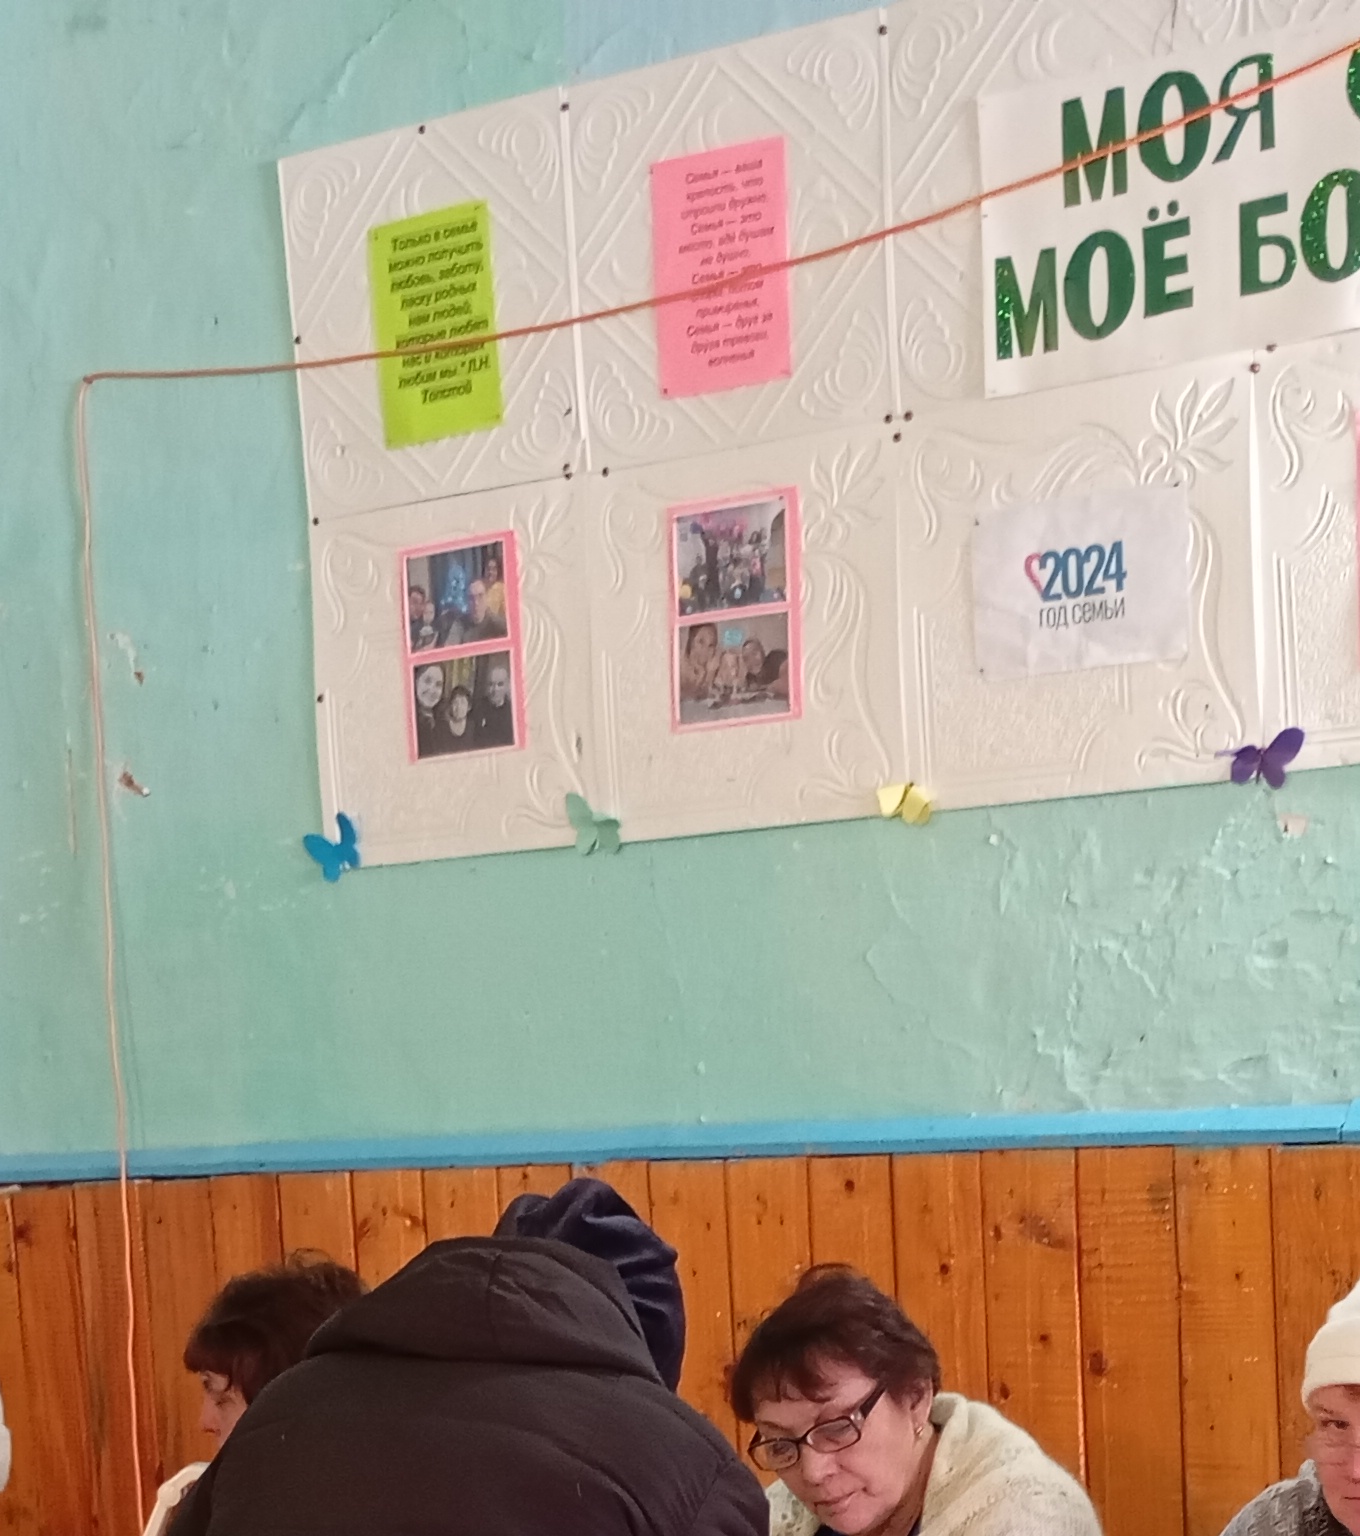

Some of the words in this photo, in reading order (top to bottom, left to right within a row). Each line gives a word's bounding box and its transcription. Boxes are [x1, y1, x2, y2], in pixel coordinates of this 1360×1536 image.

[1061, 52, 1277, 208] МОЯ
[995, 200, 1194, 361] МОЁ
[1039, 539, 1128, 603] 2024
